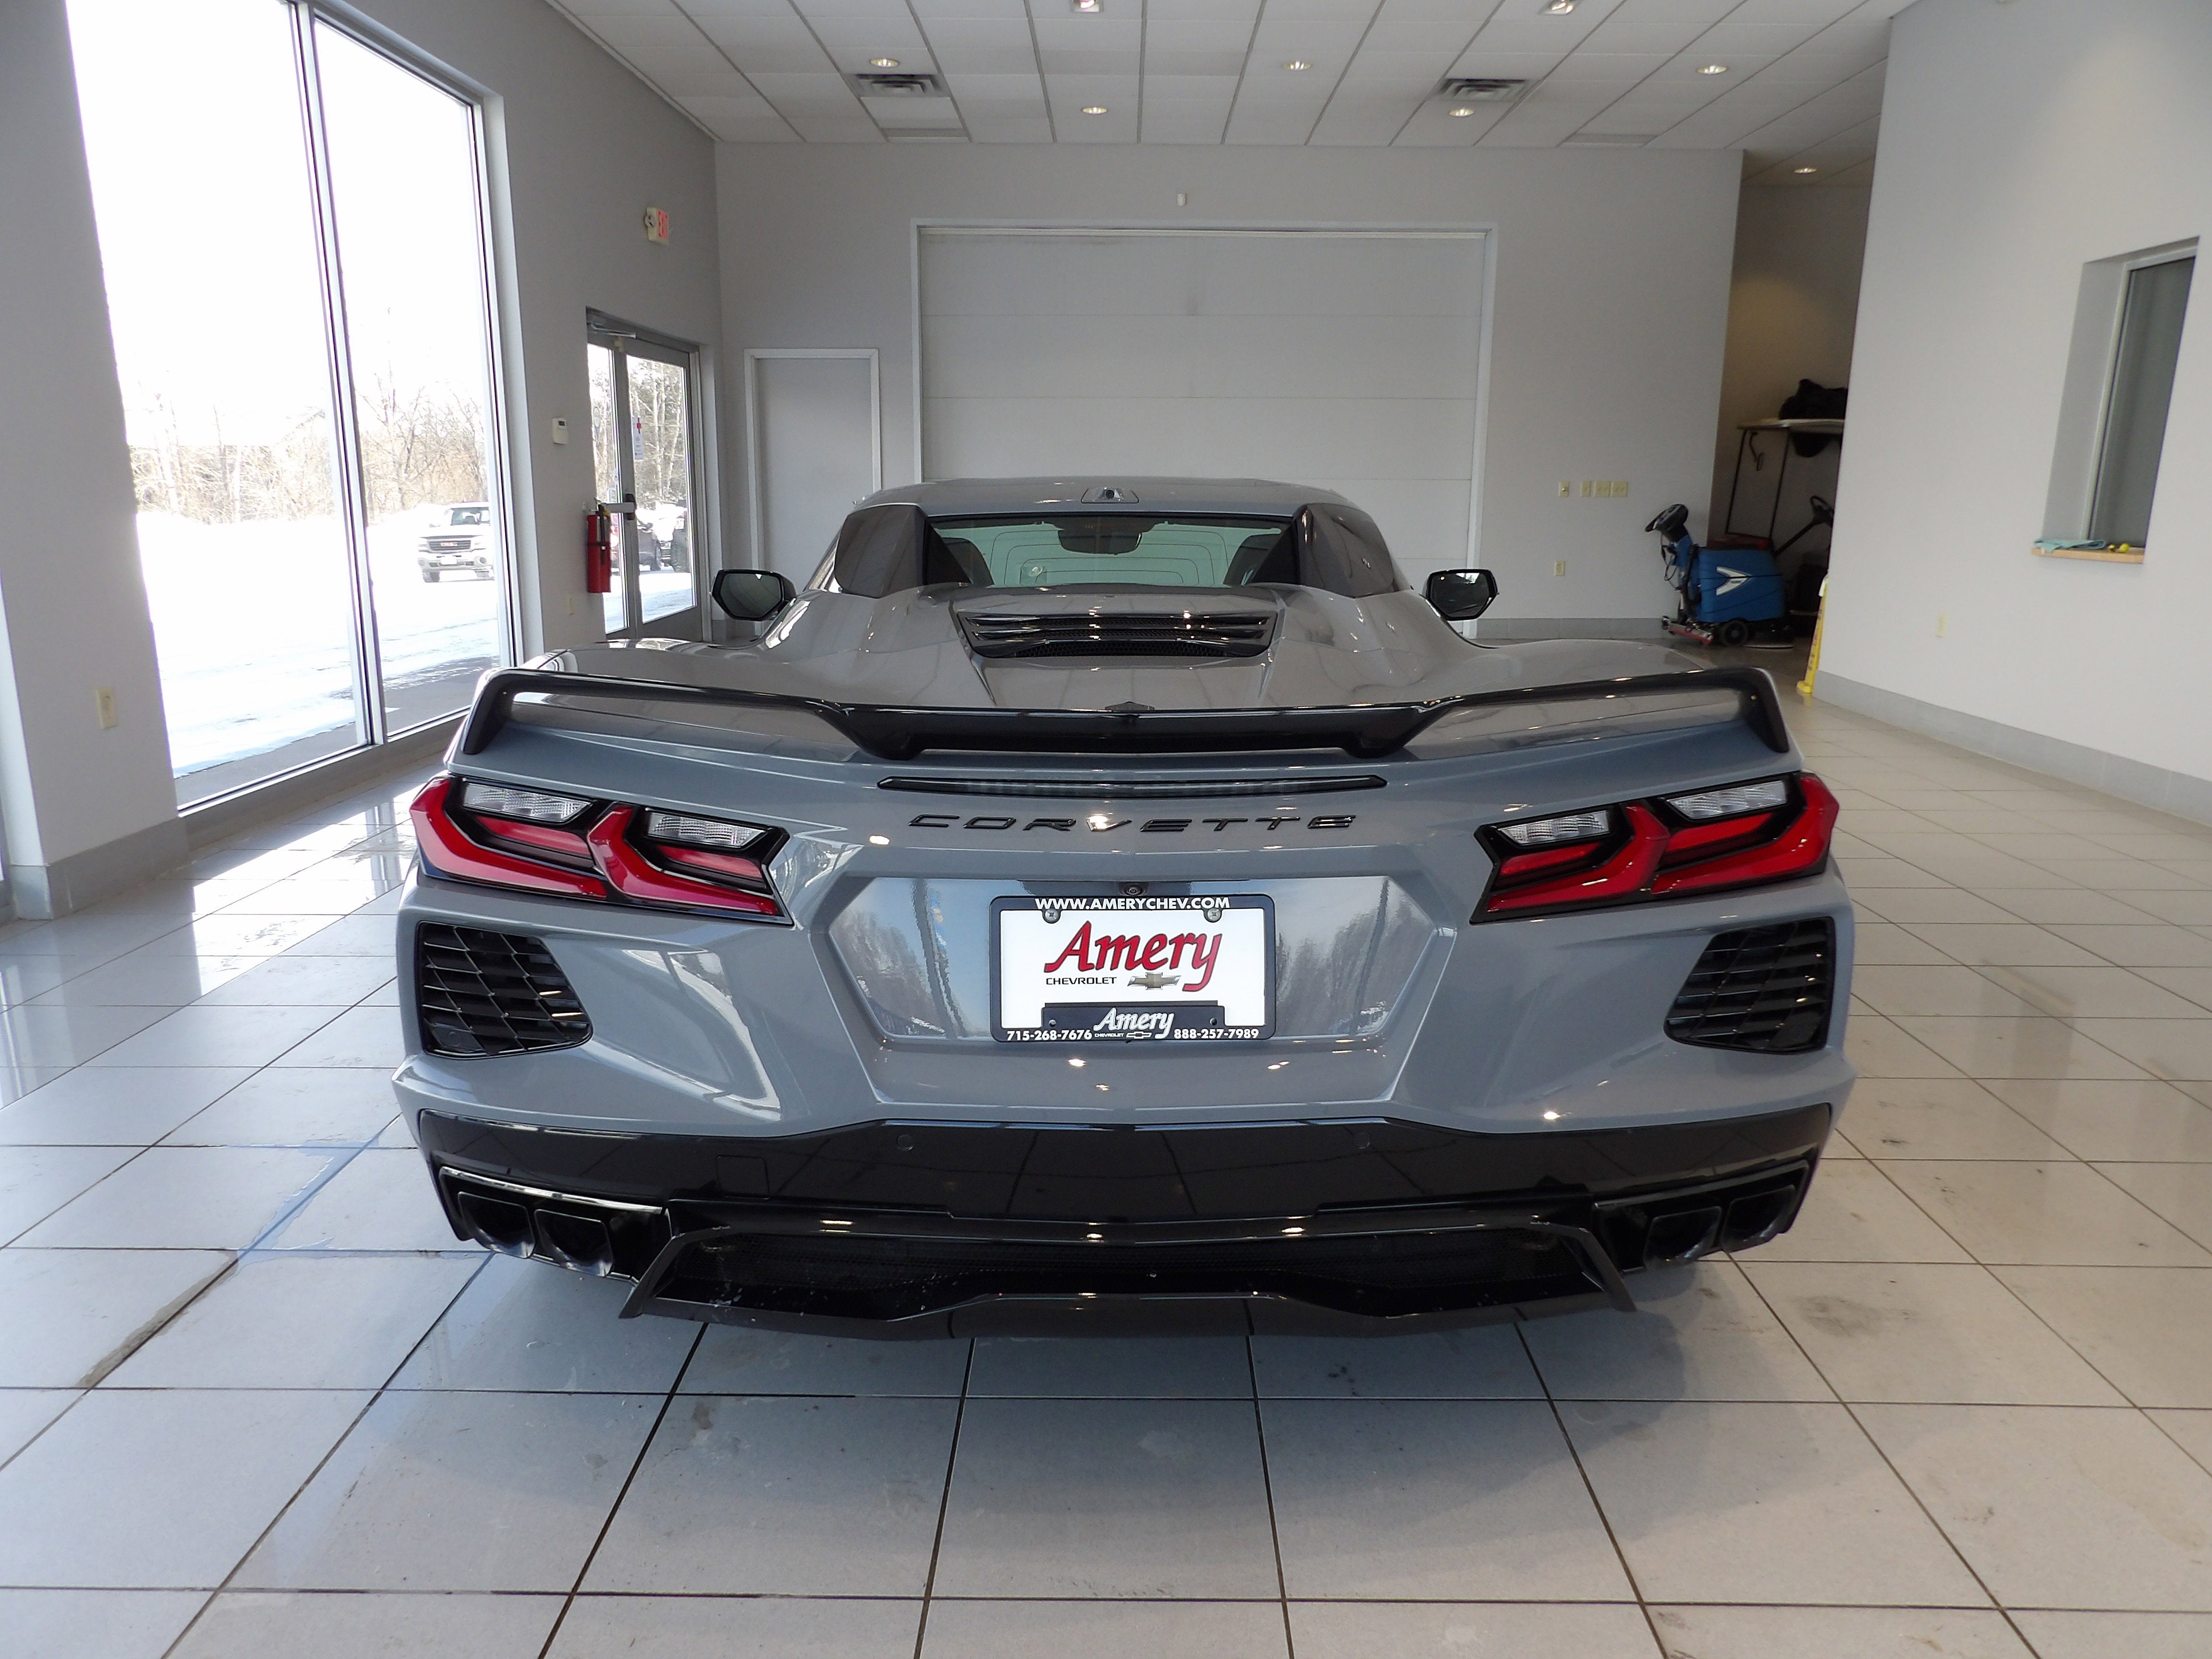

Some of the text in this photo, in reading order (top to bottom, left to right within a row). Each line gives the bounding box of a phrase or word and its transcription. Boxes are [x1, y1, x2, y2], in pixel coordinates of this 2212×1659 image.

[908, 814, 1357, 831] CORVETTE
[1035, 897, 1230, 910] WWW.AMERYCHEV.COM
[1044, 920, 1222, 992] Amery
[1046, 977, 1117, 985] CHEVROLET
[1093, 1008, 1174, 1039] Amery
[1007, 1029, 1093, 1041] 715-268-7676
[1174, 1028, 1259, 1039] 888-257-7989
